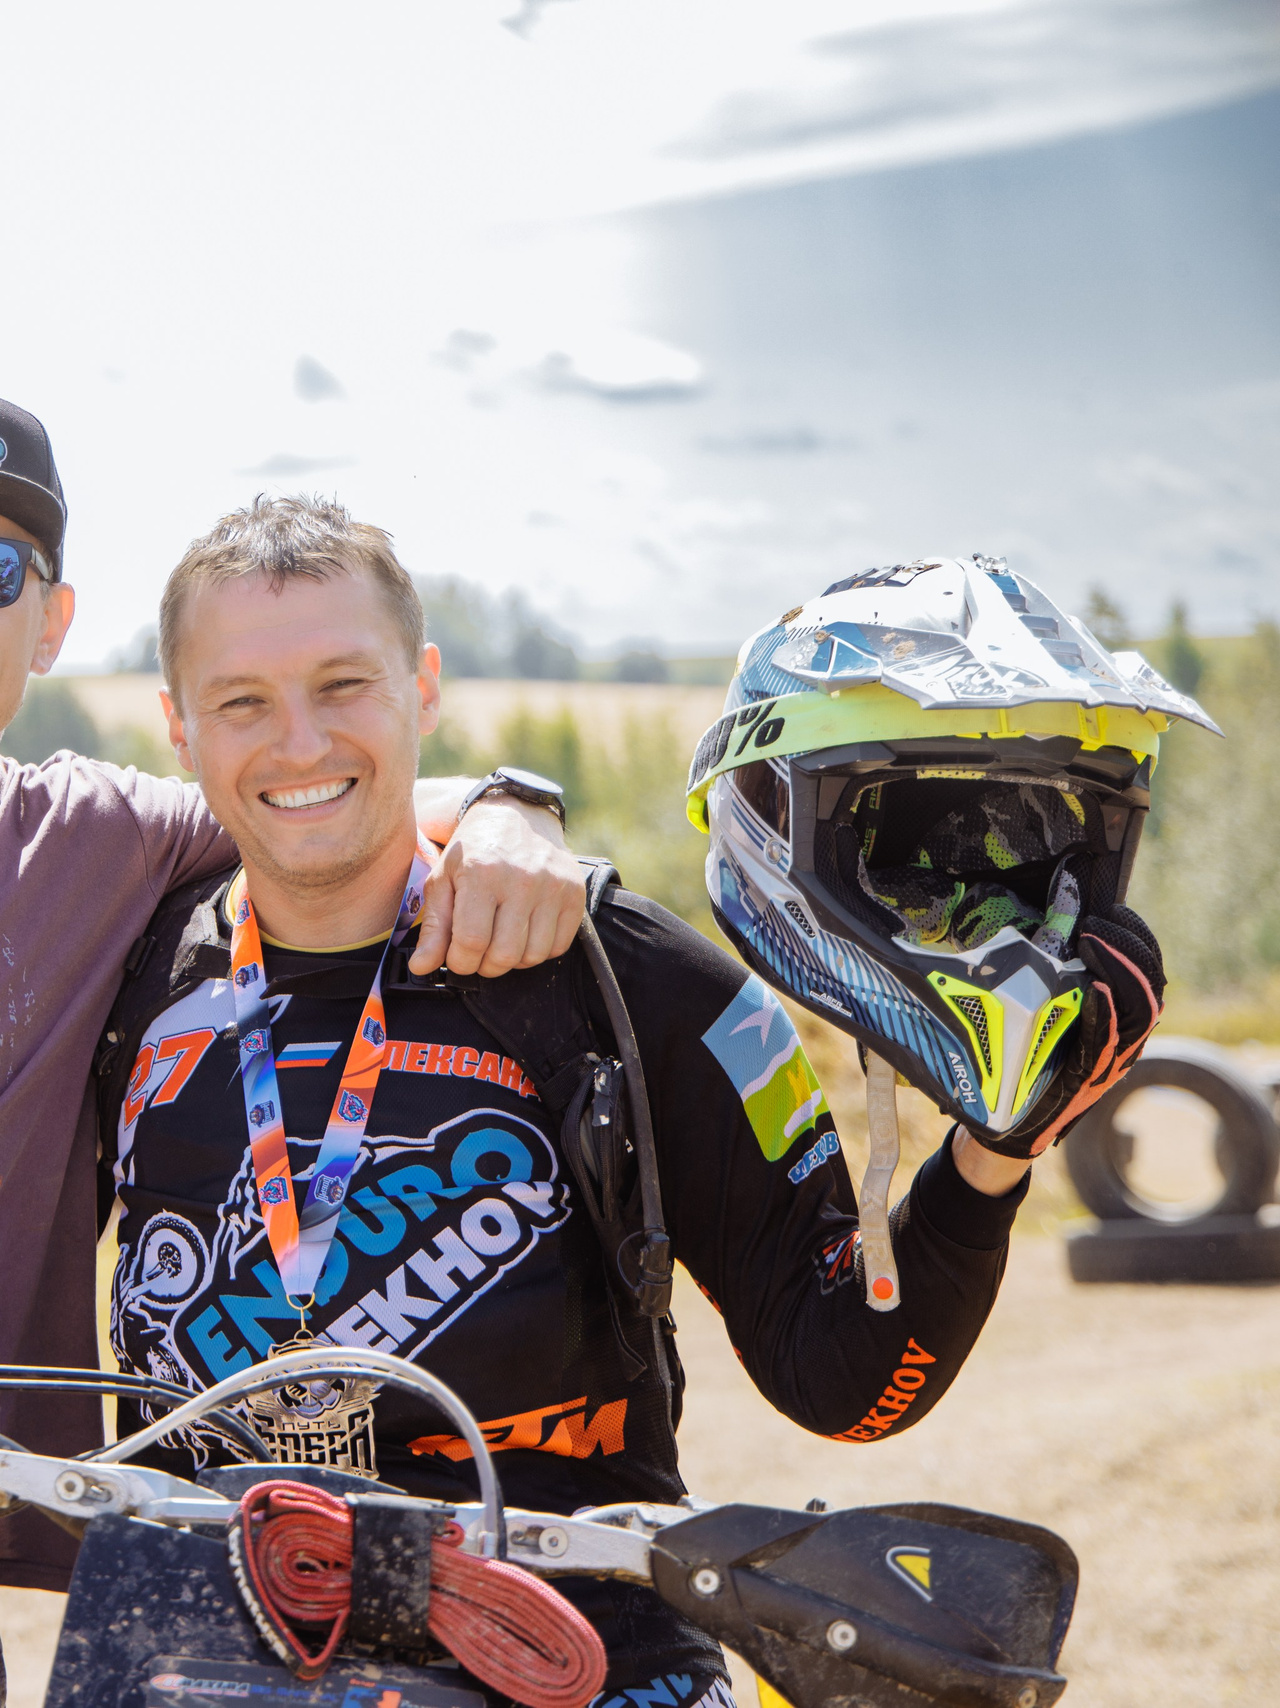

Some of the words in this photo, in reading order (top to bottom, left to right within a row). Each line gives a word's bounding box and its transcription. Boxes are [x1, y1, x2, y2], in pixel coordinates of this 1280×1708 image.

[124, 1027, 218, 1131] 27
[380, 1039, 541, 1102] ЛЕКСАН
[948, 1051, 978, 1105] AIROH
[282, 1420, 341, 1431] ПУТЬ
